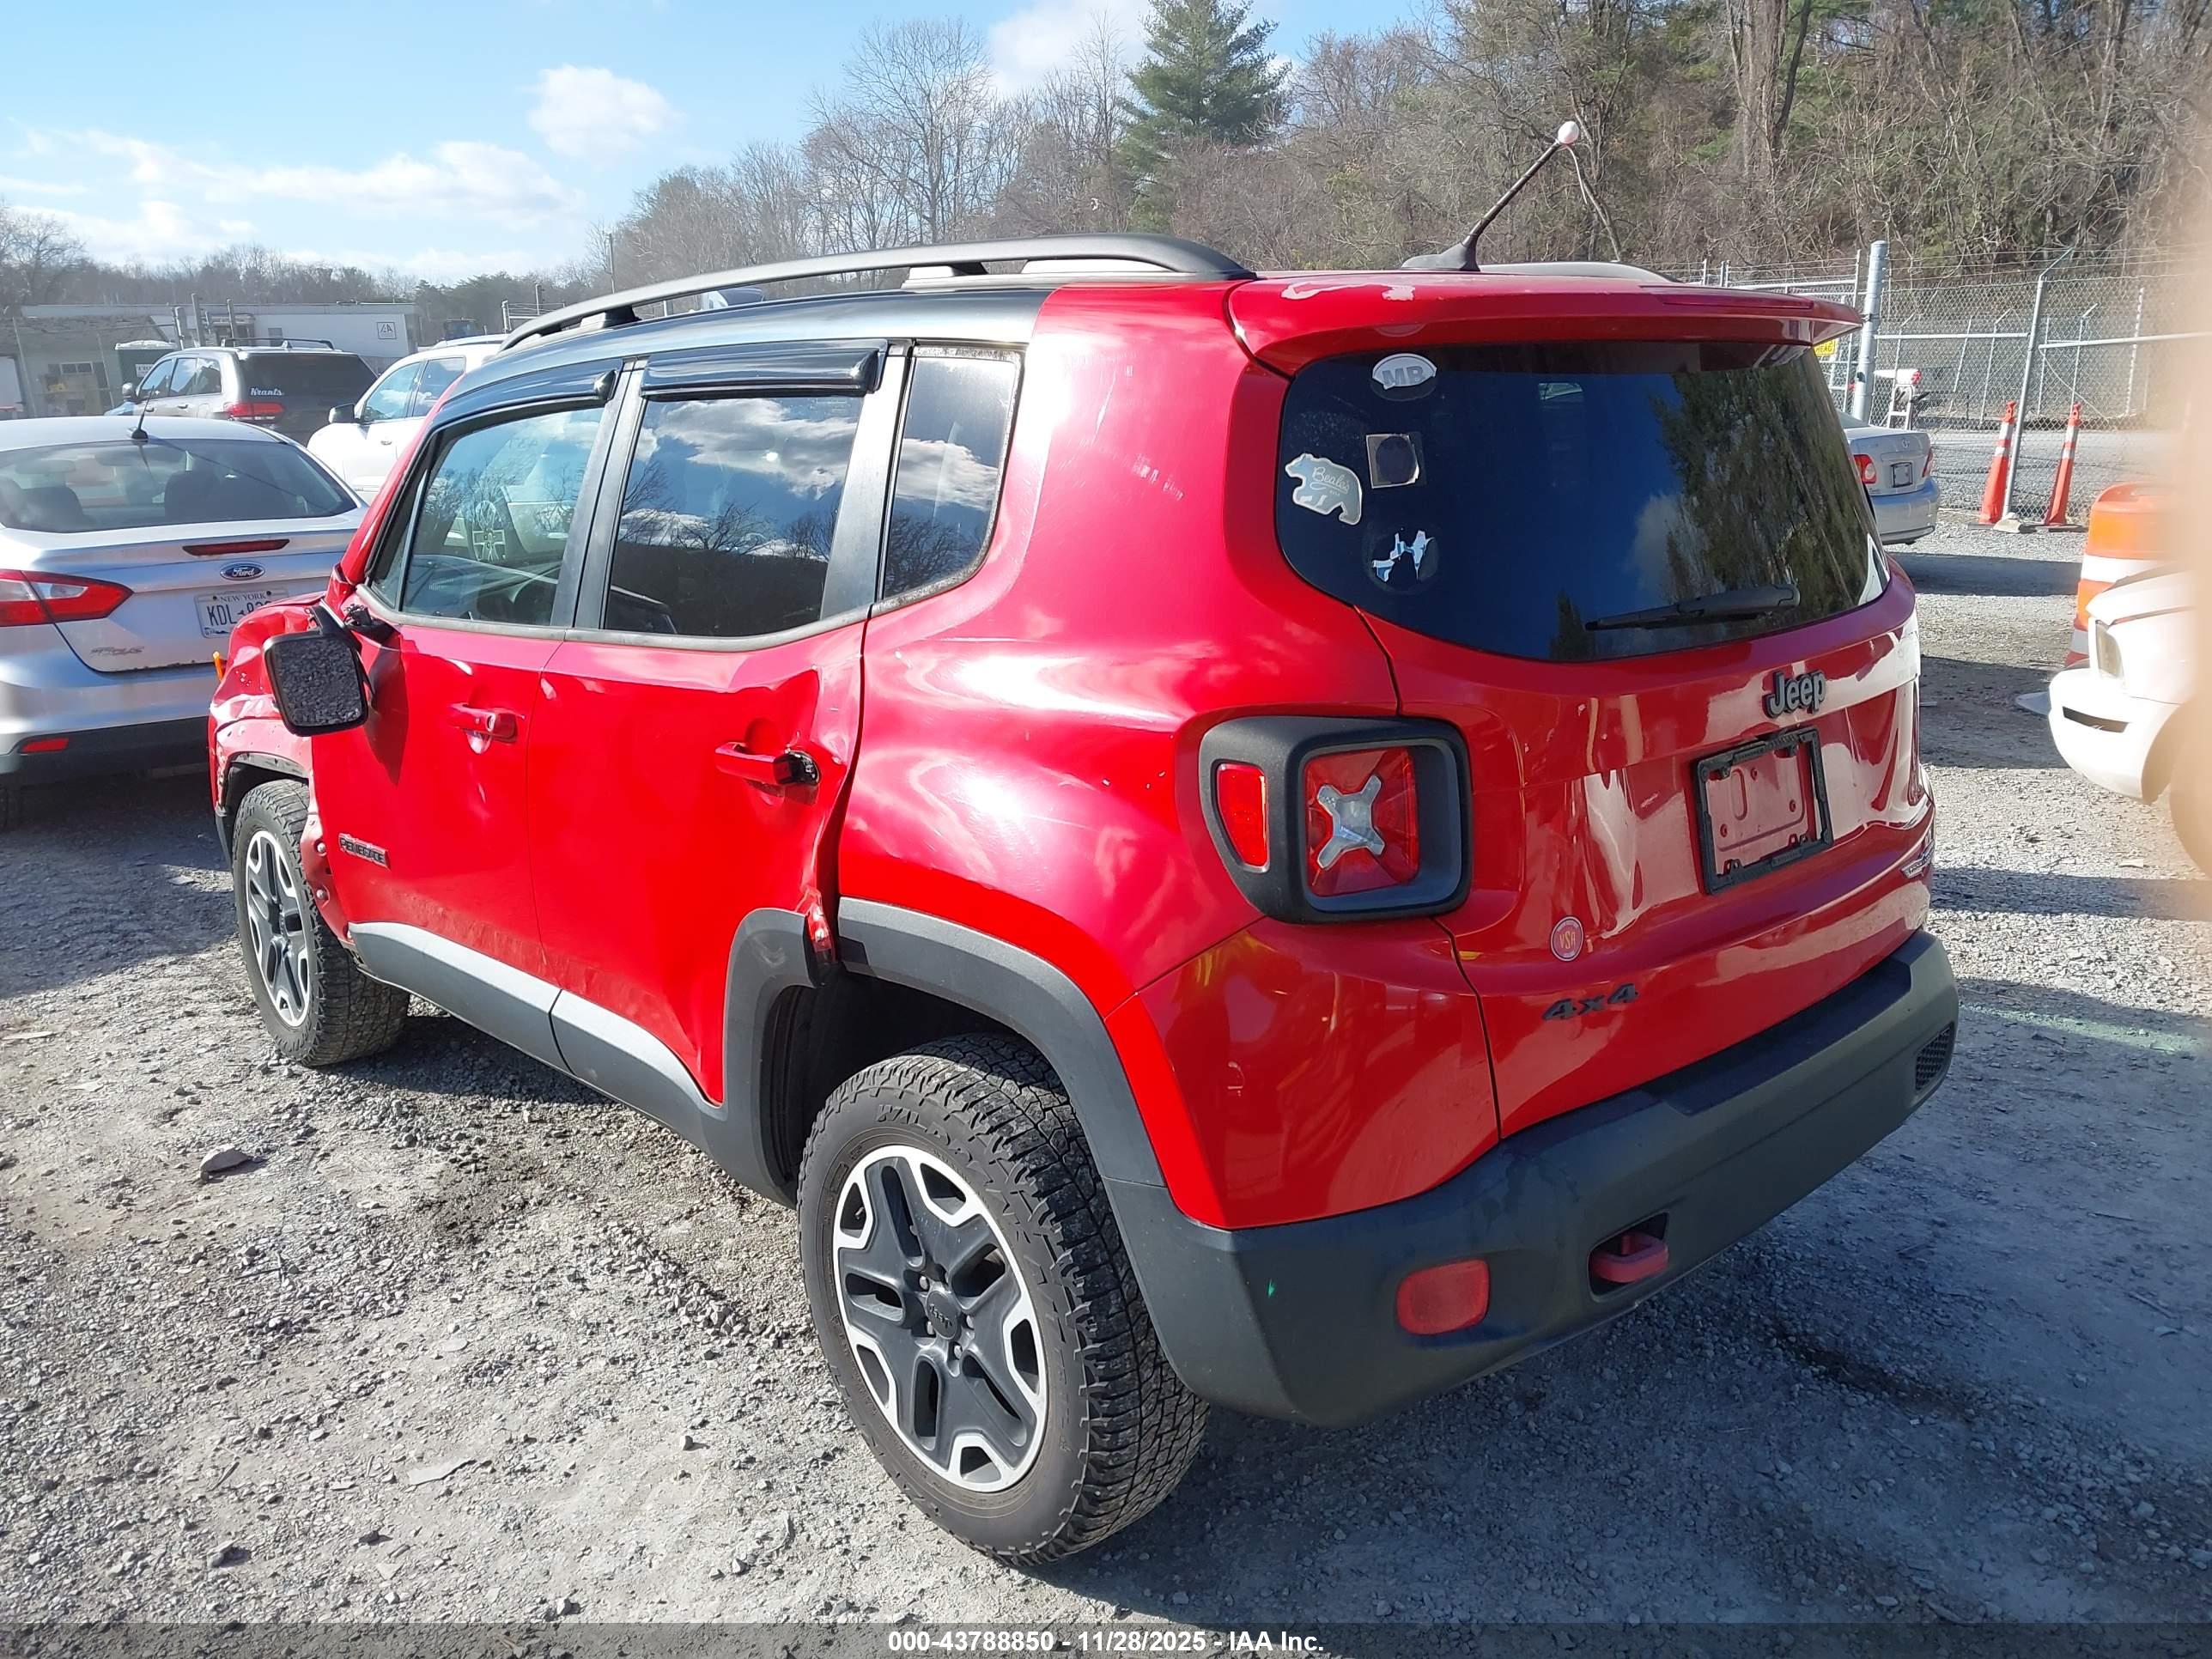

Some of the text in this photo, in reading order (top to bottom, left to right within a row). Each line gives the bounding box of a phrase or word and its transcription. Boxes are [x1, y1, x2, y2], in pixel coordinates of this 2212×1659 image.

[232, 567, 255, 577] Ford
[220, 592, 267, 603] NEW YORK
[1765, 671, 1826, 718] Jeep
[1541, 982, 1639, 1021] 4x4
